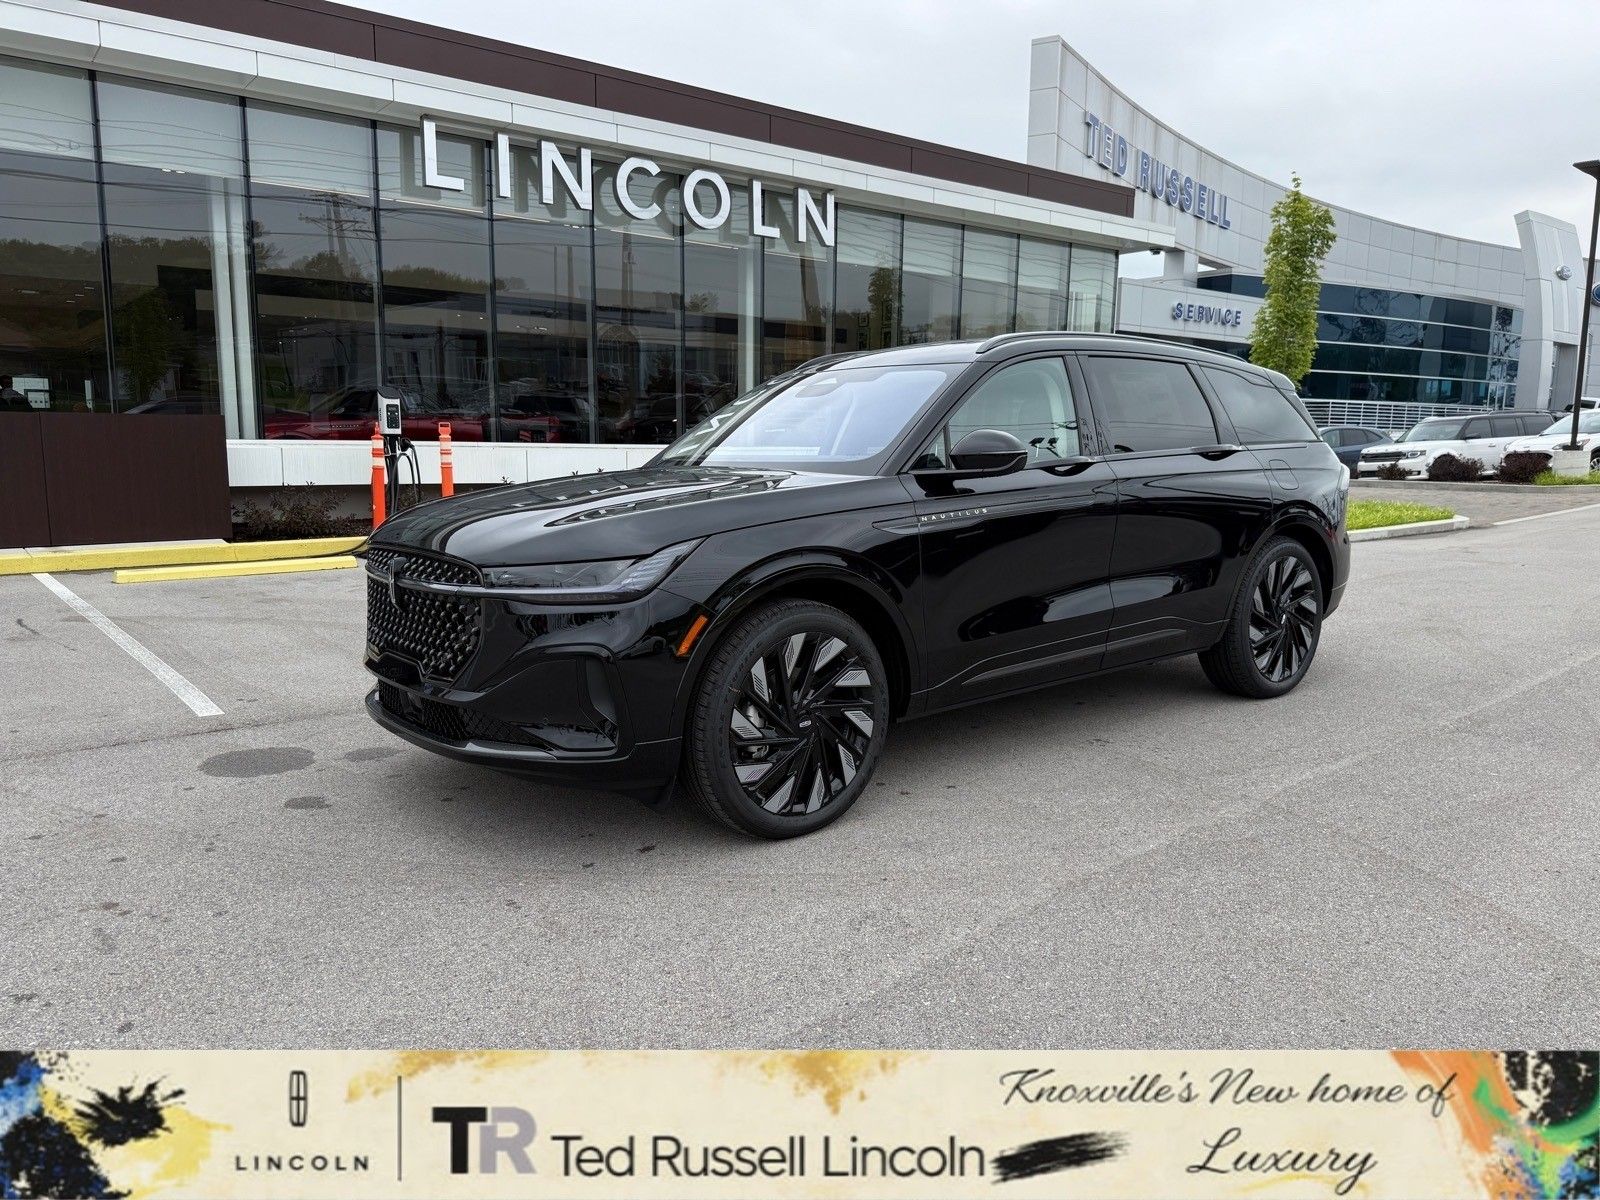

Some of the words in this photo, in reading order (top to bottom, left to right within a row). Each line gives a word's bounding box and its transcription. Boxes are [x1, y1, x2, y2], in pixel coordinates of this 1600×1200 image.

[420, 114, 835, 247] LINCOLN
[1086, 110, 1128, 177] TED
[1137, 149, 1231, 230] RUSSELL
[1173, 302, 1242, 326] SERVICE
[921, 507, 988, 522] NAUTILUS
